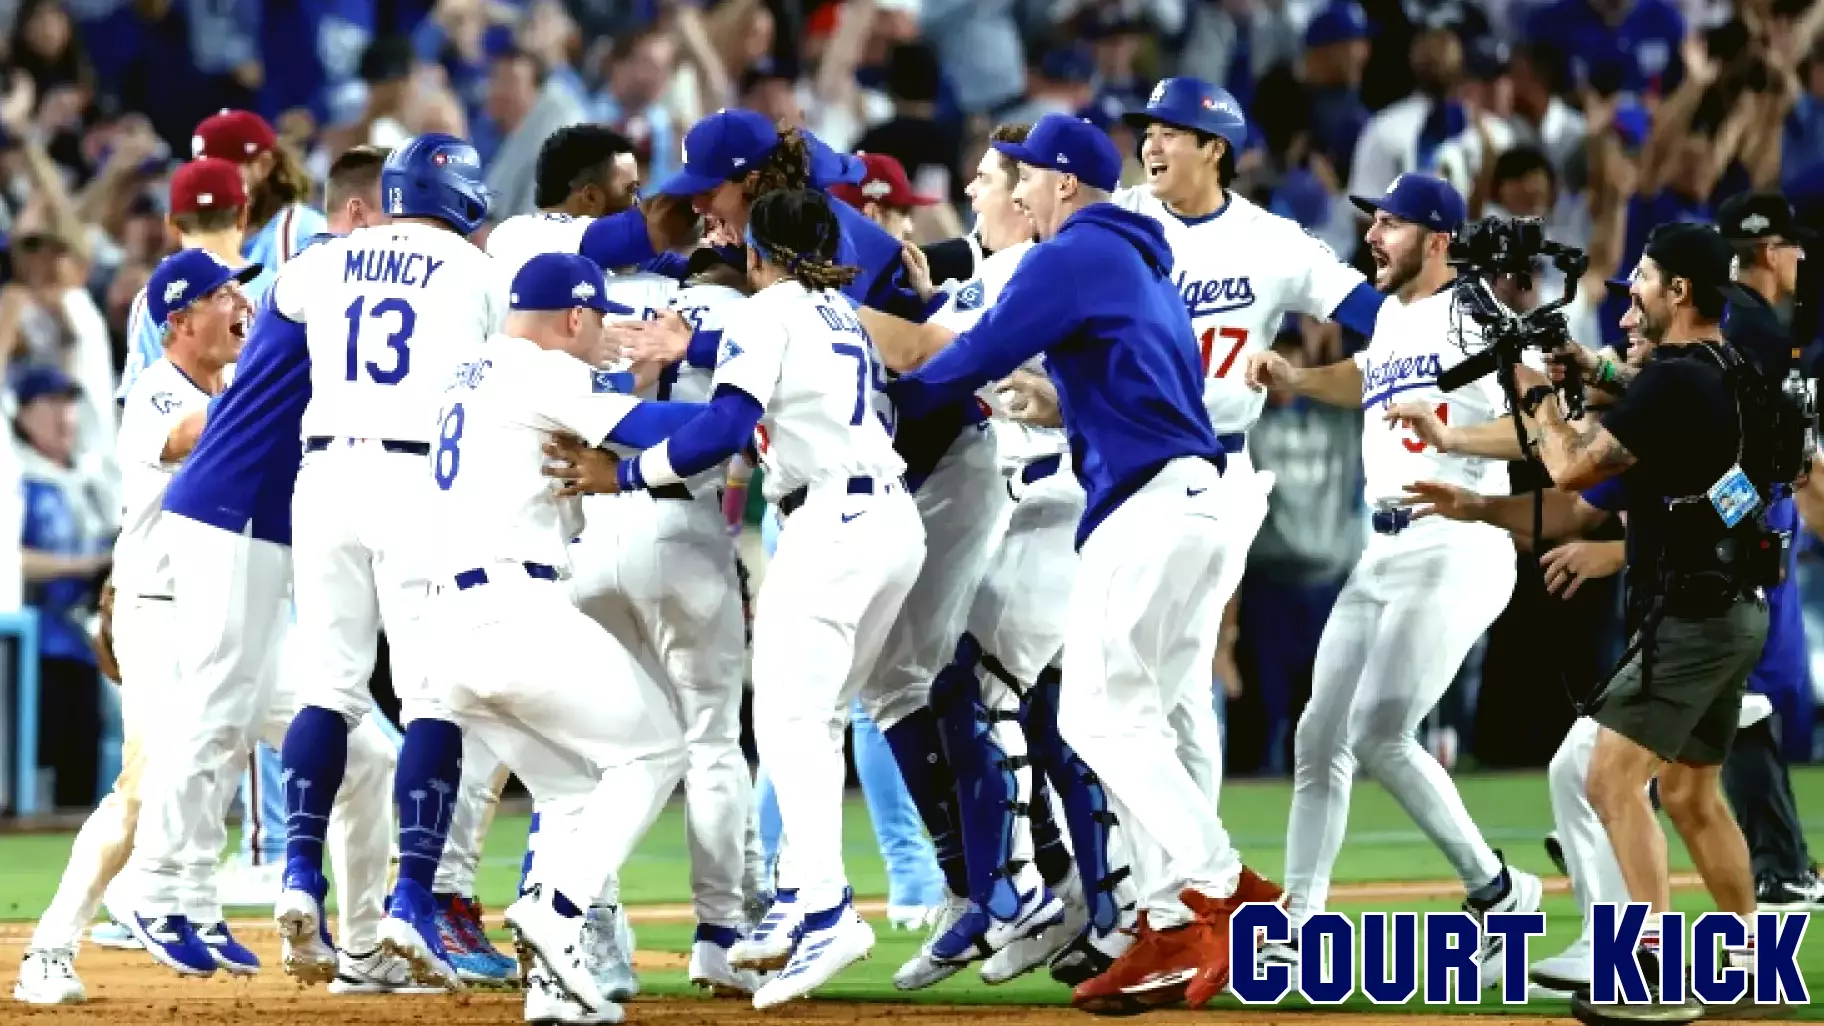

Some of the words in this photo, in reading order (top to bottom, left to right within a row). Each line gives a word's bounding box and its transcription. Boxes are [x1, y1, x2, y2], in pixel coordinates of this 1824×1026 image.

[343, 249, 444, 288] MUNCY
[1176, 270, 1255, 318] gers
[344, 295, 417, 386] 13
[1200, 326, 1249, 379] 17
